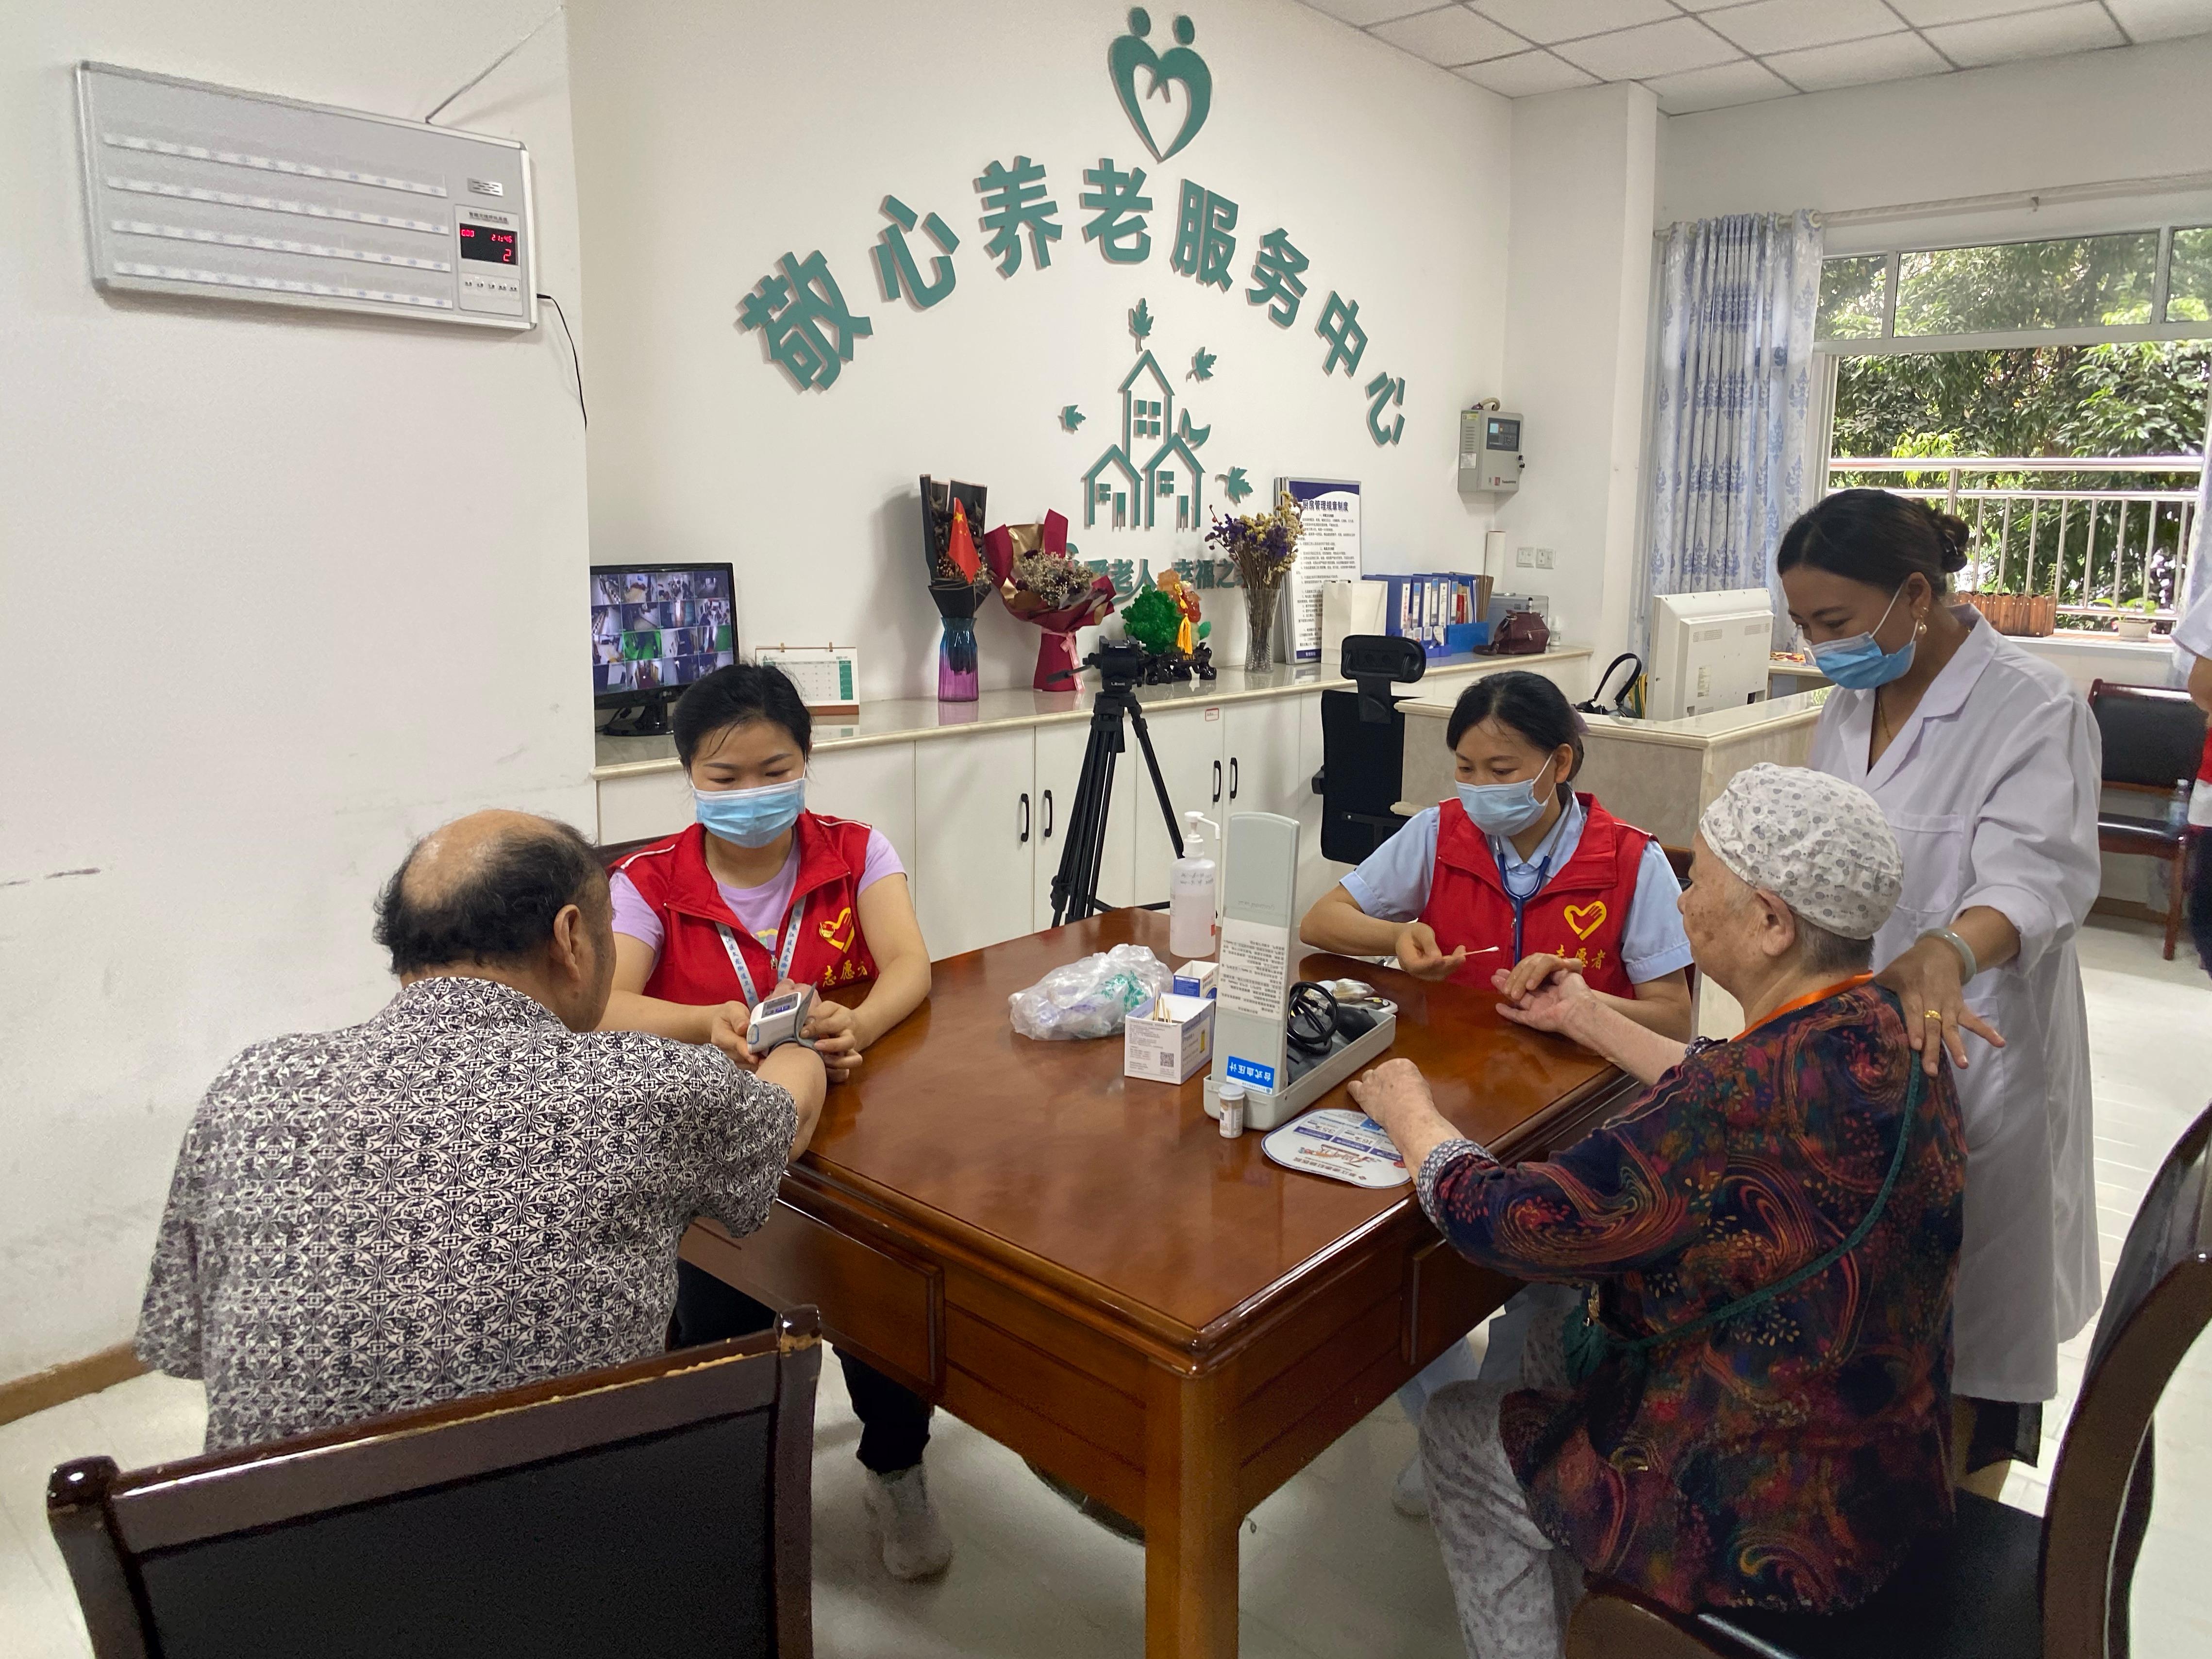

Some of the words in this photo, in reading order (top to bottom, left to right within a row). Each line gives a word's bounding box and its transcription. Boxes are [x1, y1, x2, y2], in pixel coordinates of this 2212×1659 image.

[503, 249, 511, 262] 2
[734, 155, 1405, 448] 敬心养老服务中心
[1303, 500, 1348, 511] 厨房管理规章制度
[1171, 558, 1244, 589] 幸福之
[1229, 1062, 1272, 1082] 台式血压计
